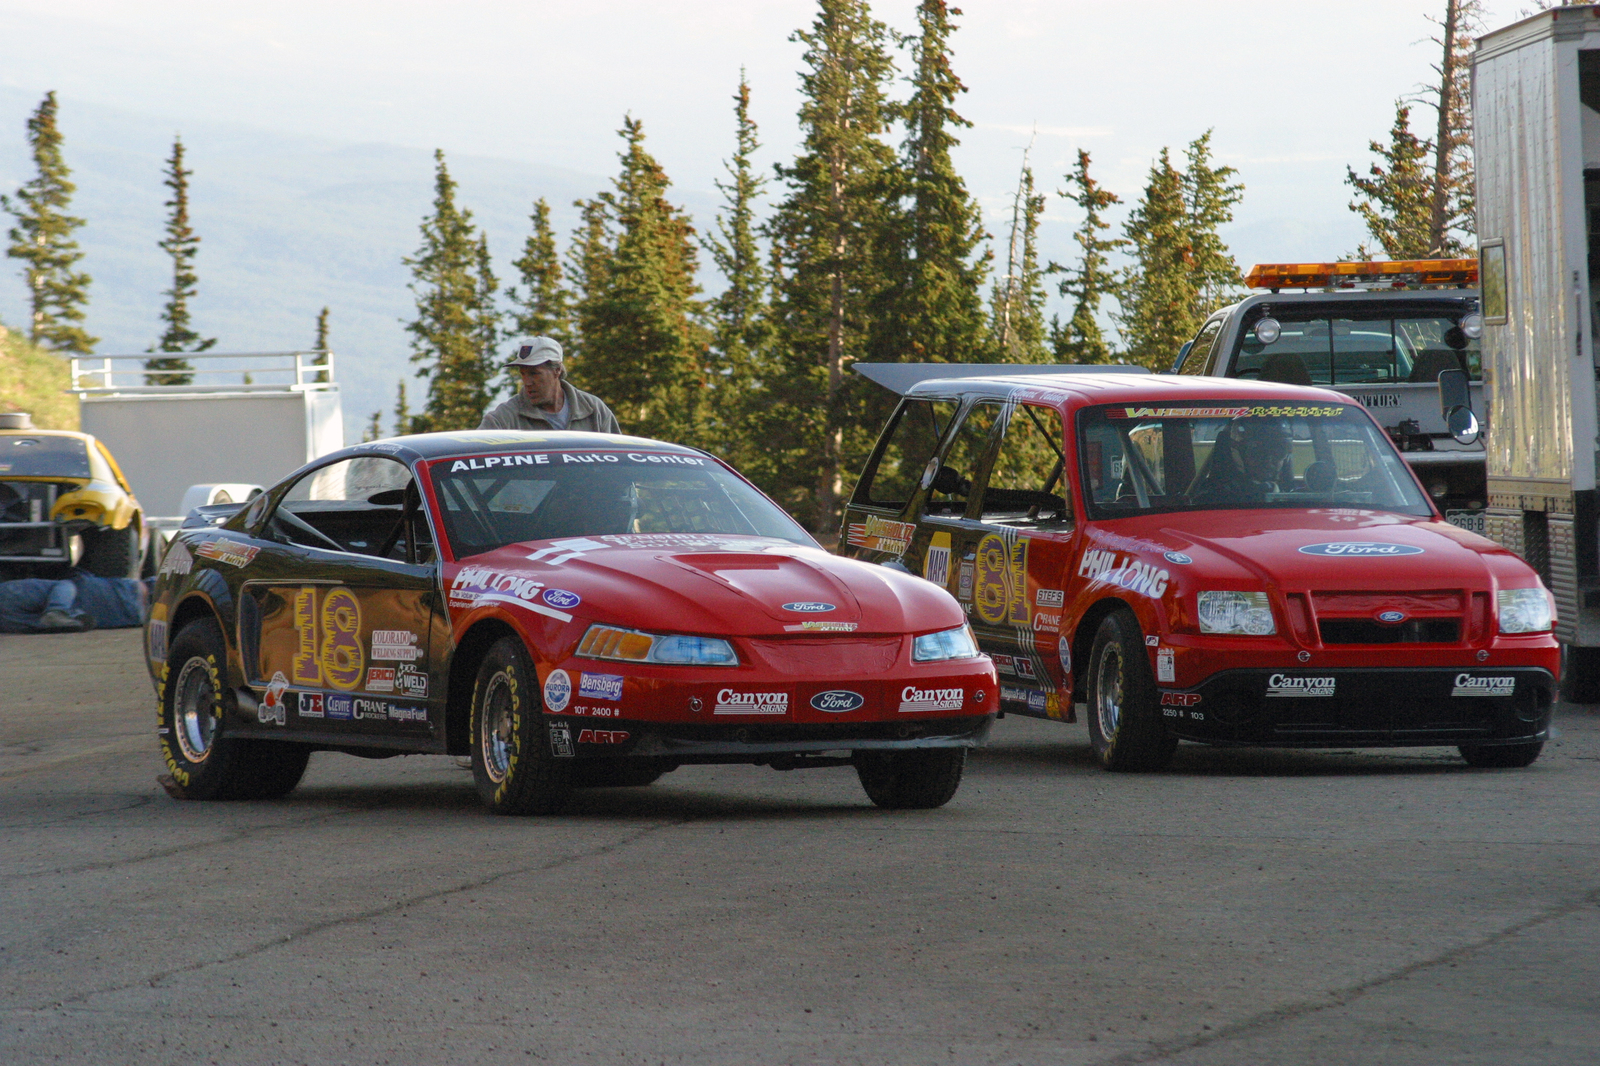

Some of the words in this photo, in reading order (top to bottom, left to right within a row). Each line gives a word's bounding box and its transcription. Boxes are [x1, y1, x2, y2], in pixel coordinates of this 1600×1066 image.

[450, 454, 550, 472] ALPINE
[562, 453, 619, 463] Auto
[627, 453, 705, 466] Center
[1325, 543, 1400, 554] Ford
[926, 549, 949, 584] NAPA
[1078, 549, 1117, 580] PHIL
[1111, 557, 1170, 599] LONG
[452, 568, 494, 590] PHIL
[490, 573, 545, 600] LONG
[975, 532, 1032, 626] 81
[547, 589, 575, 605] Ford
[294, 586, 364, 690] 18
[373, 631, 411, 645] COLORADO
[367, 668, 394, 684] JERICO
[403, 674, 427, 689] WELD
[1268, 674, 1336, 692] Canyon
[1455, 673, 1516, 692] Canyon
[545, 682, 570, 693] AURORA
[581, 674, 621, 697] Bensberg
[1308, 687, 1335, 695] SIGNS
[1490, 687, 1515, 695] SIGNS
[717, 688, 789, 709] Canyon
[820, 693, 853, 708] Ford
[901, 686, 964, 705] Canyon
[1161, 692, 1202, 706] ARP
[353, 699, 388, 720] CRANE
[592, 707, 611, 716] 2400
[759, 704, 788, 713] SIGNS
[939, 700, 964, 709] SIGNS
[388, 705, 427, 721] MagnaFuel
[577, 729, 631, 744] ARP
